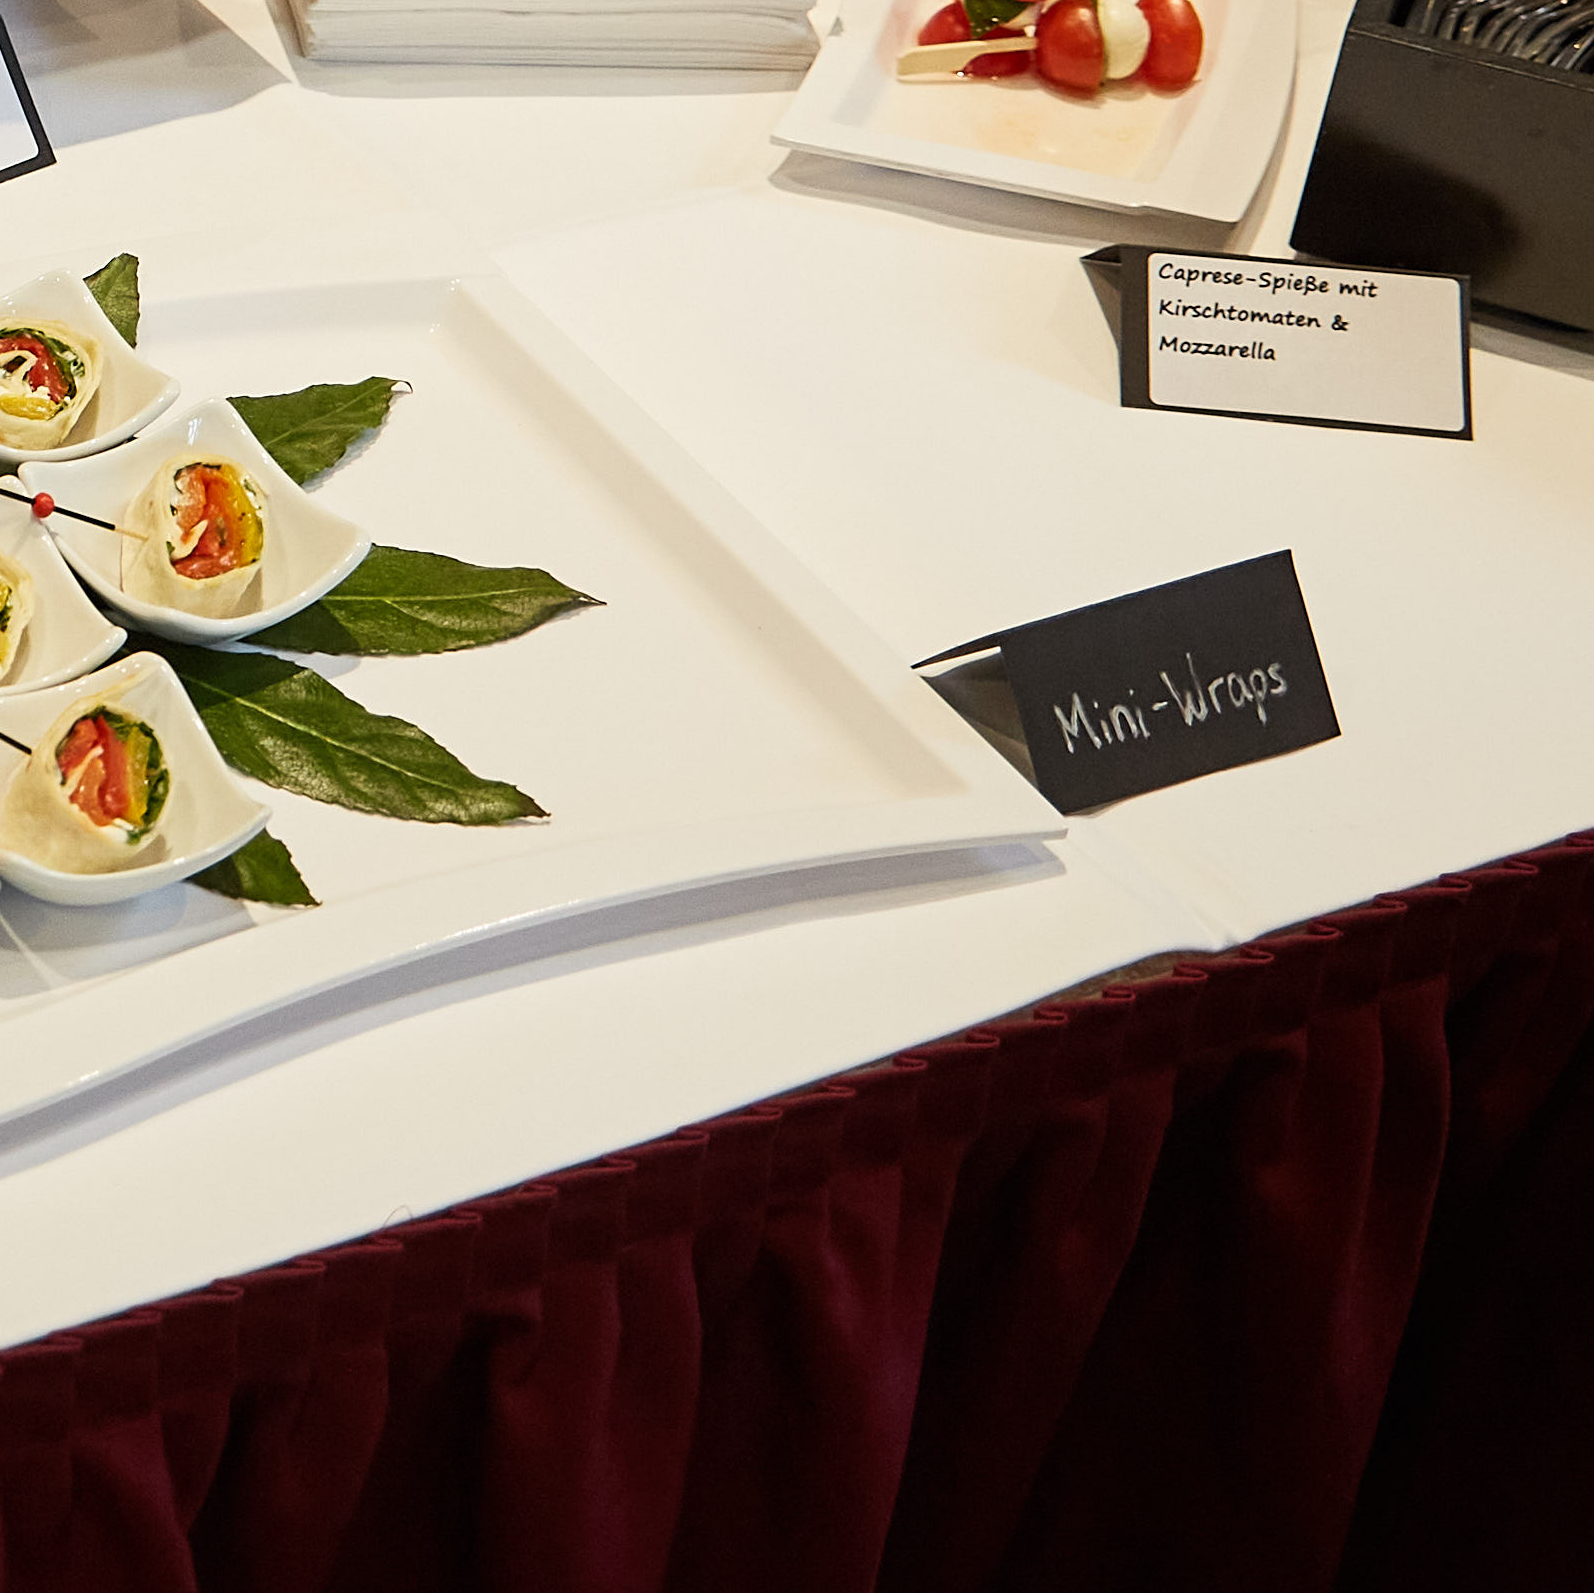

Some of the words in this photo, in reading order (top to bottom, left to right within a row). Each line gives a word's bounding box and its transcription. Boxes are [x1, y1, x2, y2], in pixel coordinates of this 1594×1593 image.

[1158, 262, 1330, 296] Caprese-Spieße
[1338, 280, 1380, 299] mit
[1158, 298, 1321, 330] Kirschtomaten
[1330, 314, 1350, 332] &
[1158, 335, 1277, 362] Mozzarella
[1053, 652, 1288, 754] Mini-Wraps
